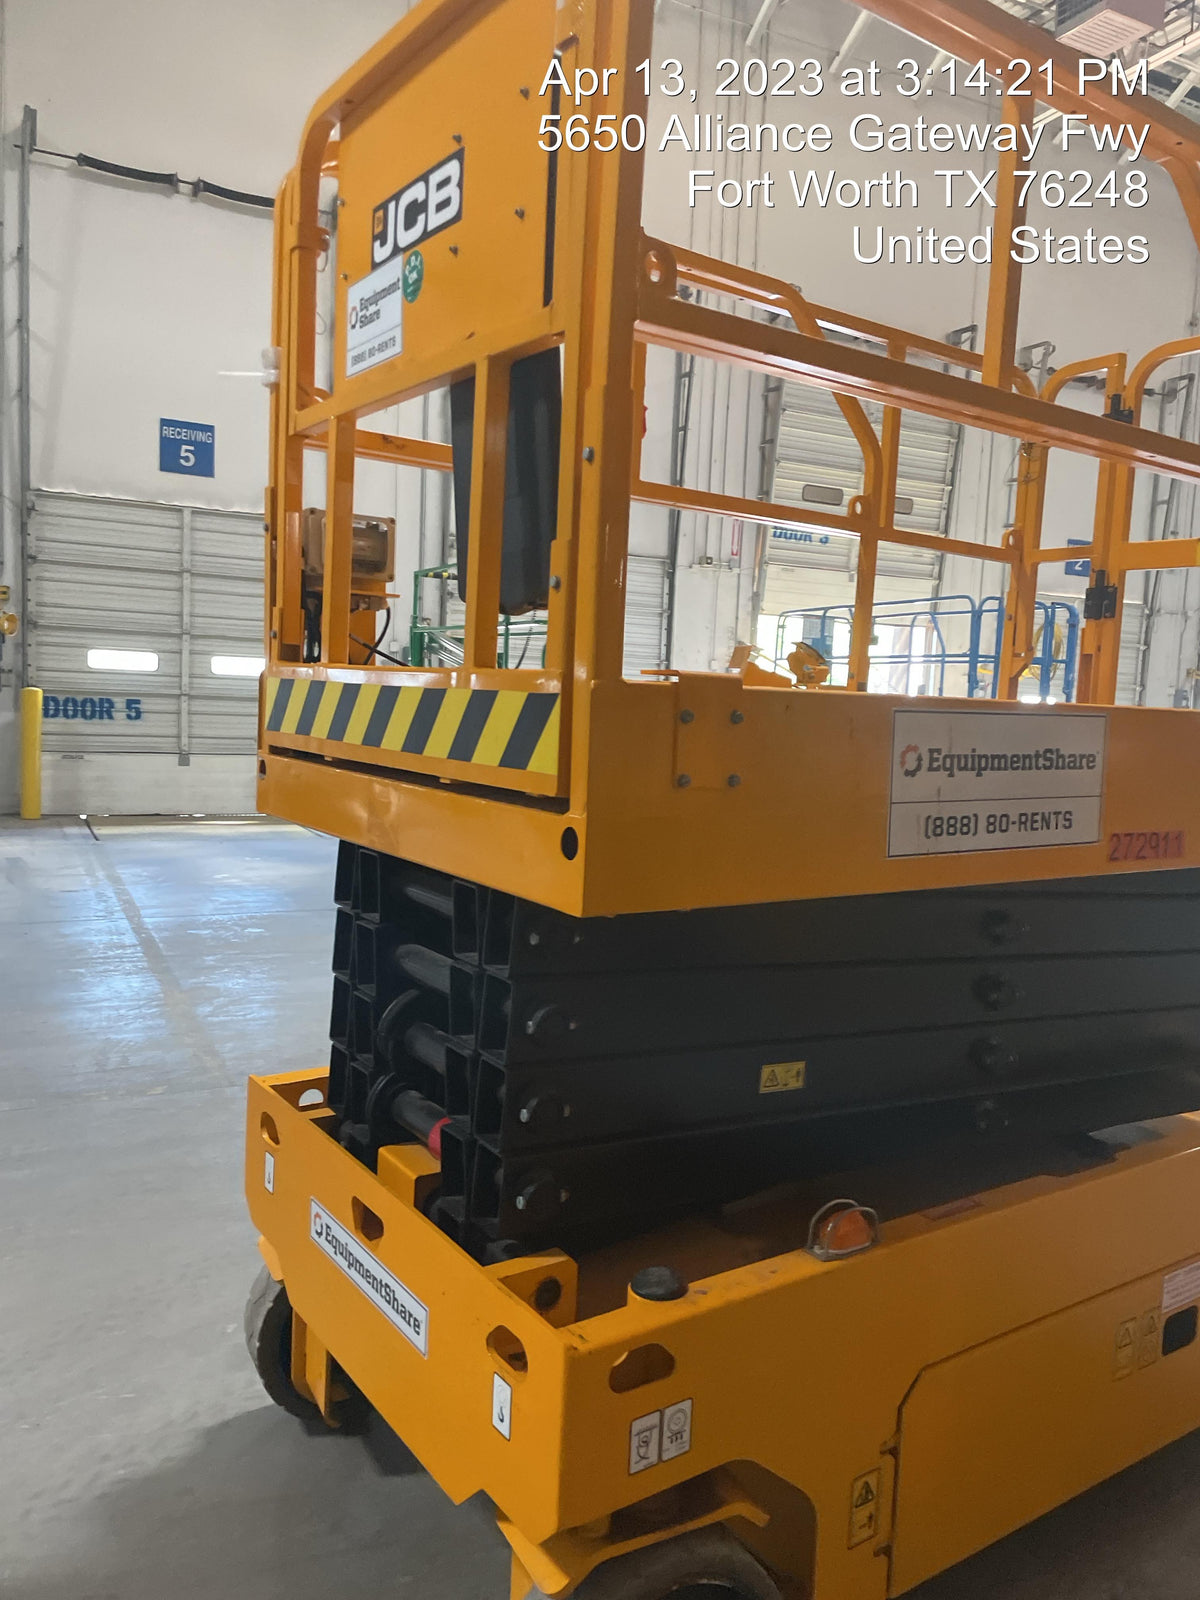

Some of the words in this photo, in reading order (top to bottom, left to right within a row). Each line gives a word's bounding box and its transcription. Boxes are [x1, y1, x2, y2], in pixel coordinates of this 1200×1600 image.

[373, 158, 461, 265] JCB
[359, 276, 400, 313] Equipment
[359, 308, 381, 330] Share
[162, 426, 213, 444] RECEIVING
[179, 444, 195, 467] 5
[43, 695, 115, 721] DOOR
[125, 698, 142, 721] 5
[927, 748, 1097, 778] EquipmentShare
[924, 814, 979, 839] (888)
[986, 811, 1073, 835] 80-RENTS
[1109, 831, 1184, 862] 272911
[324, 1223, 421, 1336] EquipmentShare
